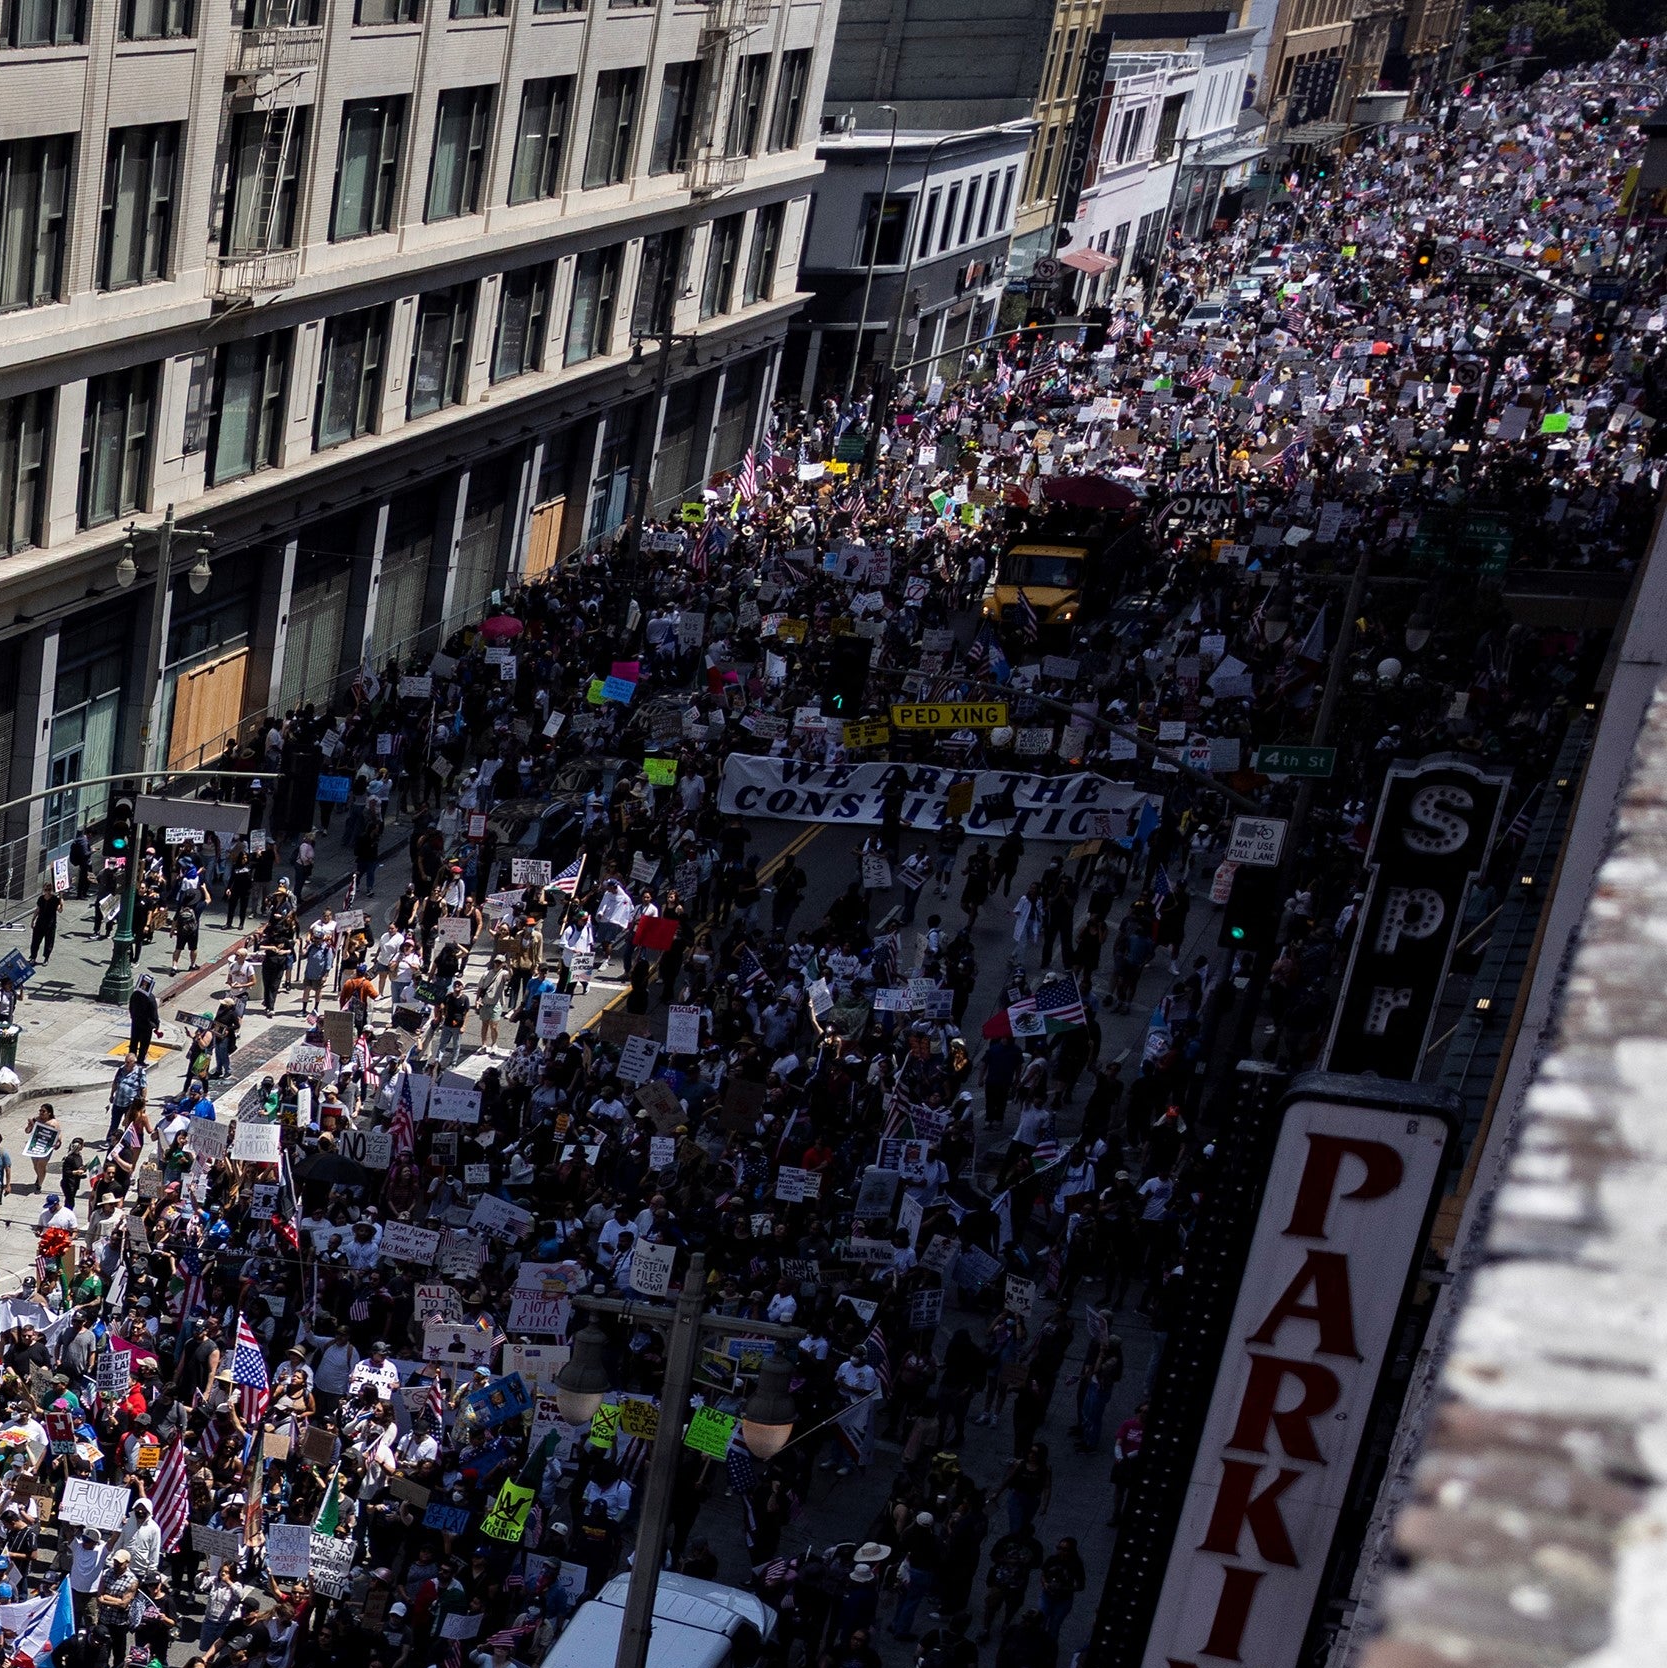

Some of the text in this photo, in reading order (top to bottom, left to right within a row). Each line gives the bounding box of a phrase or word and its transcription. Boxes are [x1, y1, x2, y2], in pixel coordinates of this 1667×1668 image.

[901, 705, 999, 724] PED XING
[1264, 751, 1326, 768] 4th St
[780, 759, 858, 789] WE
[1000, 774, 1108, 804] THE
[1235, 840, 1275, 851] MAY USE
[1229, 850, 1275, 862] FULL LANE
[636, 1268, 663, 1283] FILES
[515, 1313, 562, 1330] KING
[72, 1482, 128, 1509] FUCK
[77, 1504, 126, 1528] ICE
